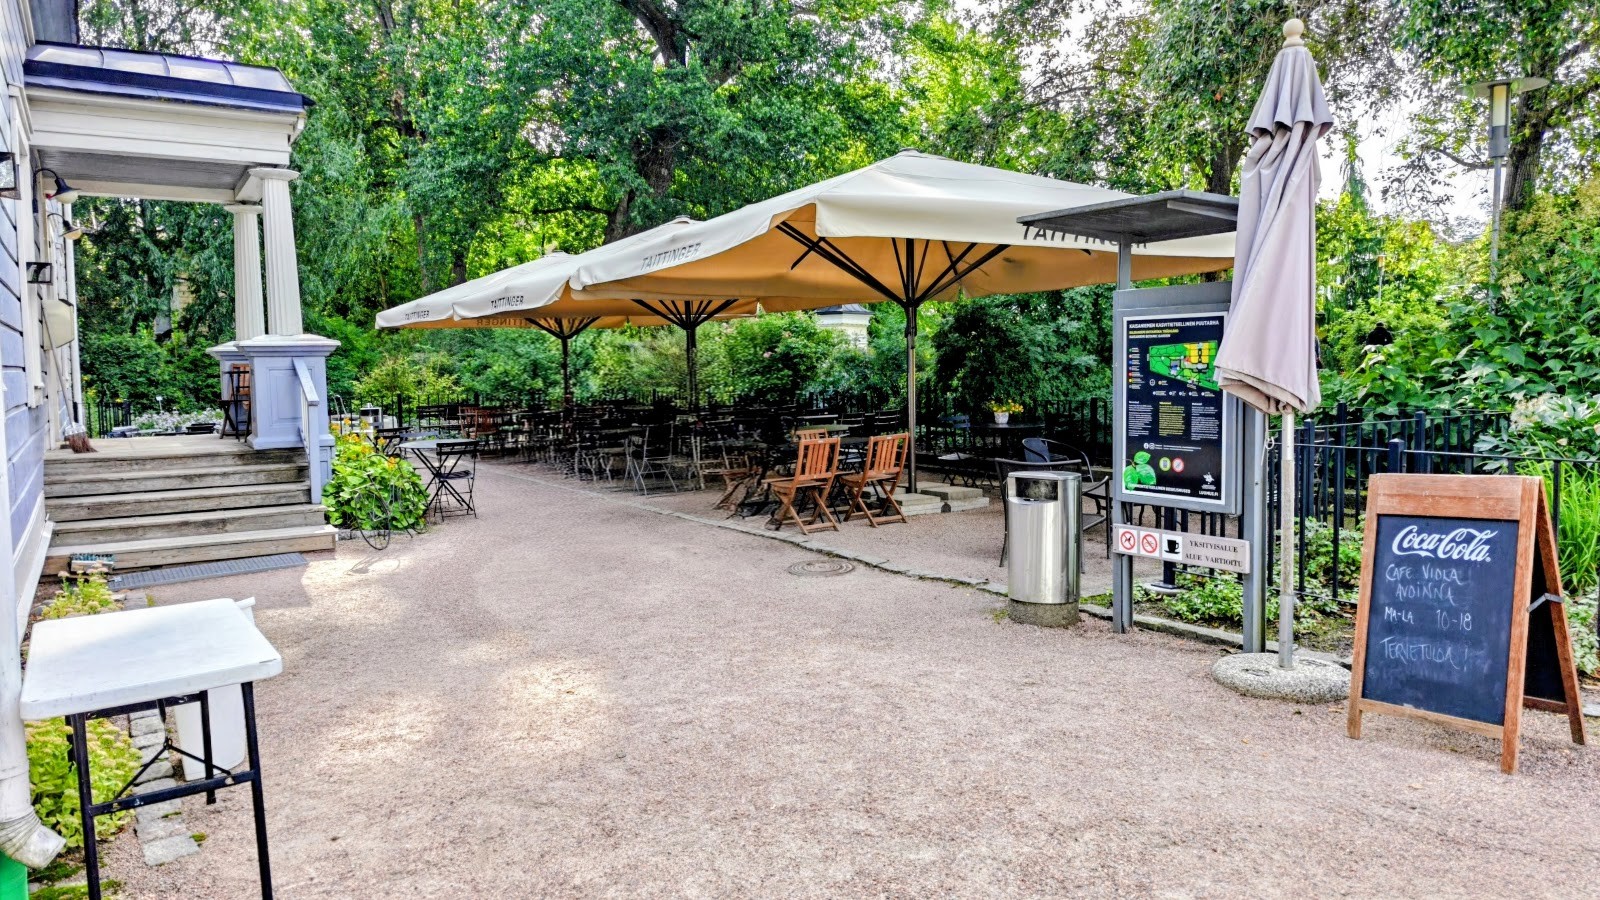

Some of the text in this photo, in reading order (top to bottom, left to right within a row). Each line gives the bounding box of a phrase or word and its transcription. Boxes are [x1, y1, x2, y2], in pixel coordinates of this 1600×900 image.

[641, 242, 702, 271] TAITTINGER
[491, 295, 524, 310] TAITTINGER
[1190, 540, 1238, 553] YKSITYISALUE
[1392, 525, 1498, 562] Coca-Cola
[1185, 553, 1243, 568] ALUE VARTIOITU
[1385, 563, 1413, 581] CAFE
[1384, 606, 1415, 625] MA-LA
[1380, 636, 1460, 670] TERVETULOA
